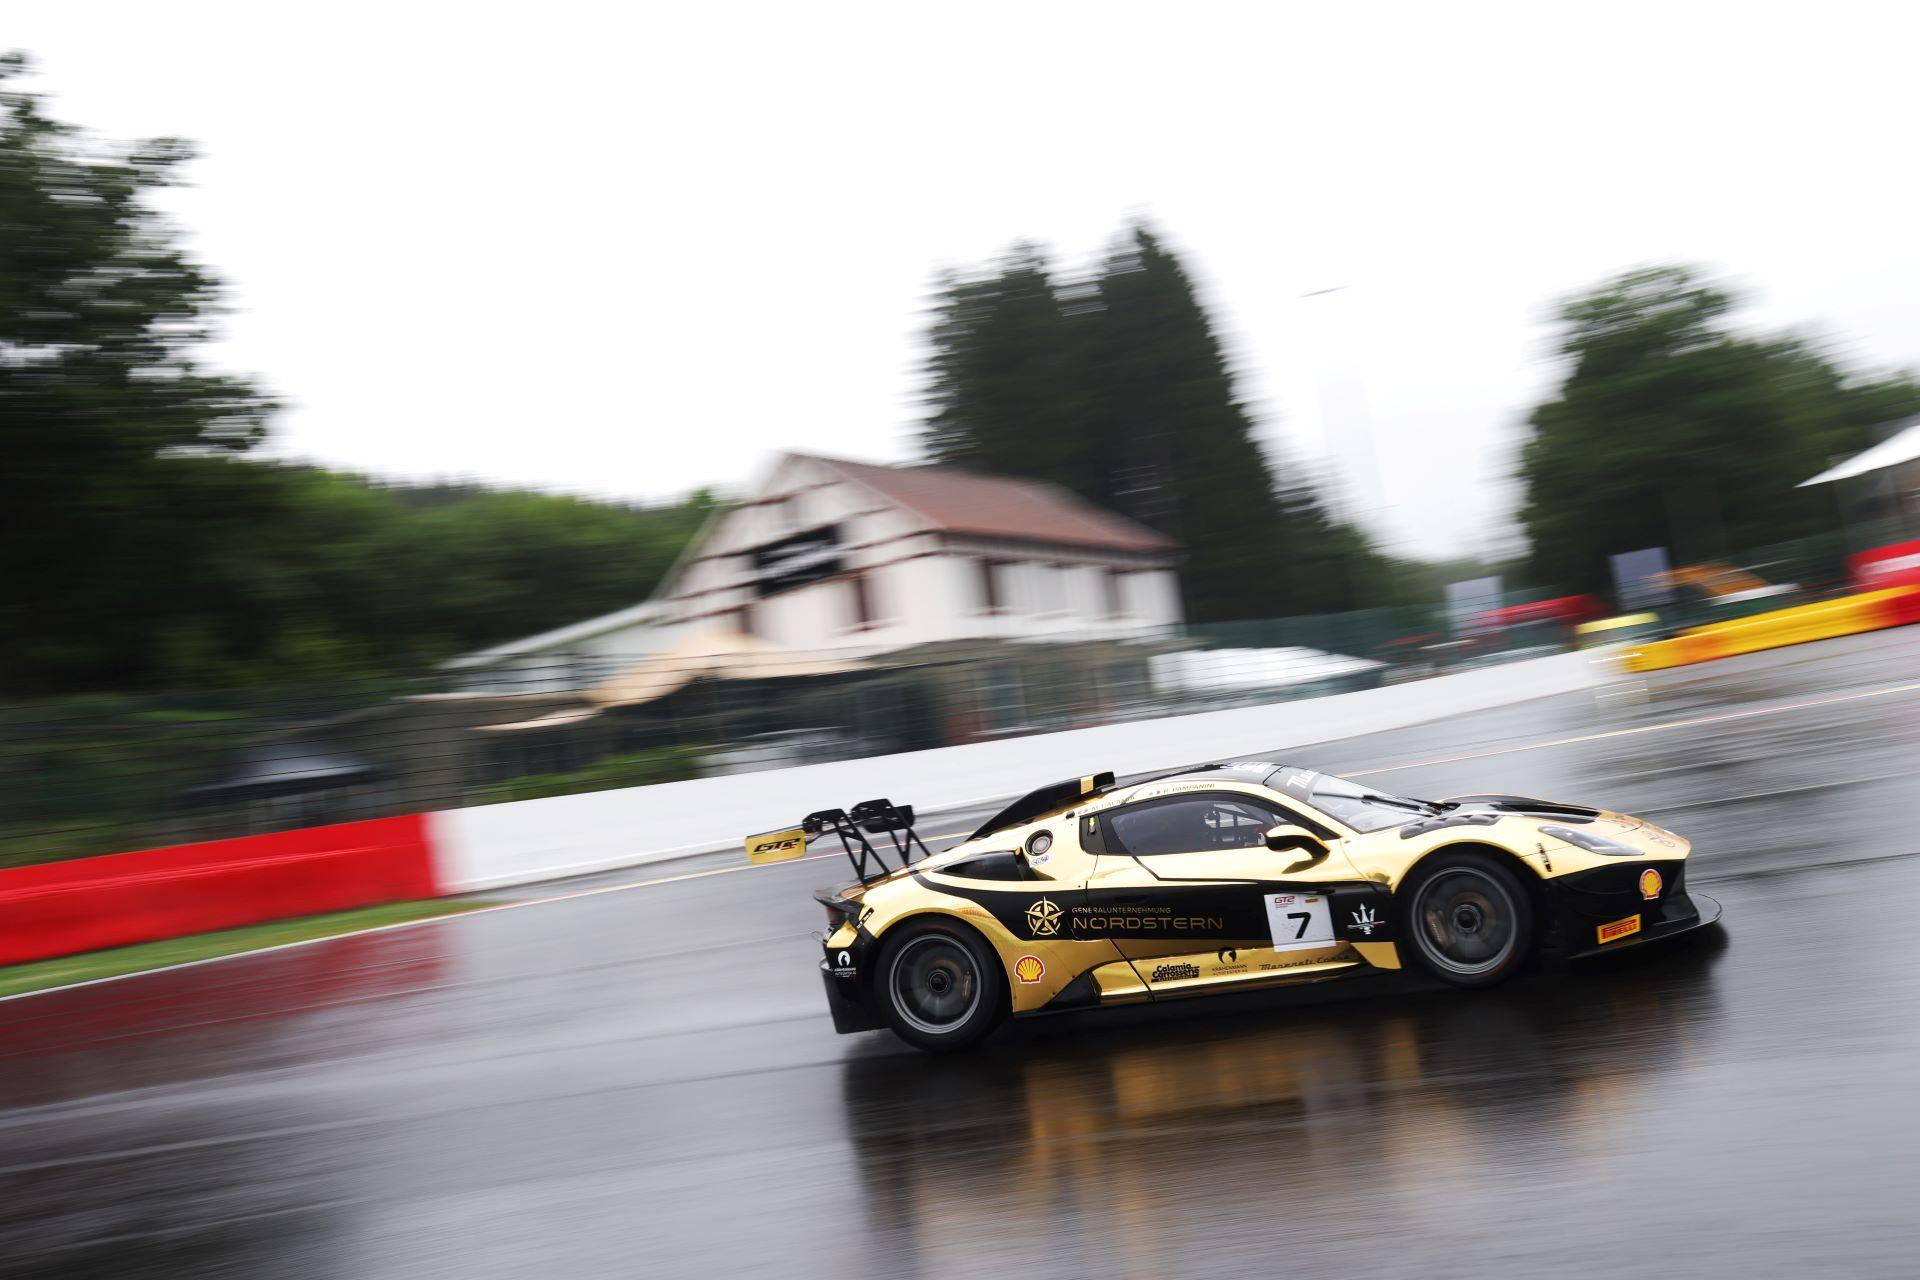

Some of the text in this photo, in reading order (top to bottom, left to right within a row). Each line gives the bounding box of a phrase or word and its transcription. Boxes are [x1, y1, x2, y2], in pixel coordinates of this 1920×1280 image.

[1274, 896, 1295, 904] GT2
[1073, 917, 1223, 929] NORDSTERN
[1287, 911, 1311, 939] 7
[1601, 919, 1637, 939] PIRELLI
[1156, 962, 1192, 973] Calamia
[1259, 959, 1315, 970] Maserati
[1152, 968, 1200, 979] Carrosserie
